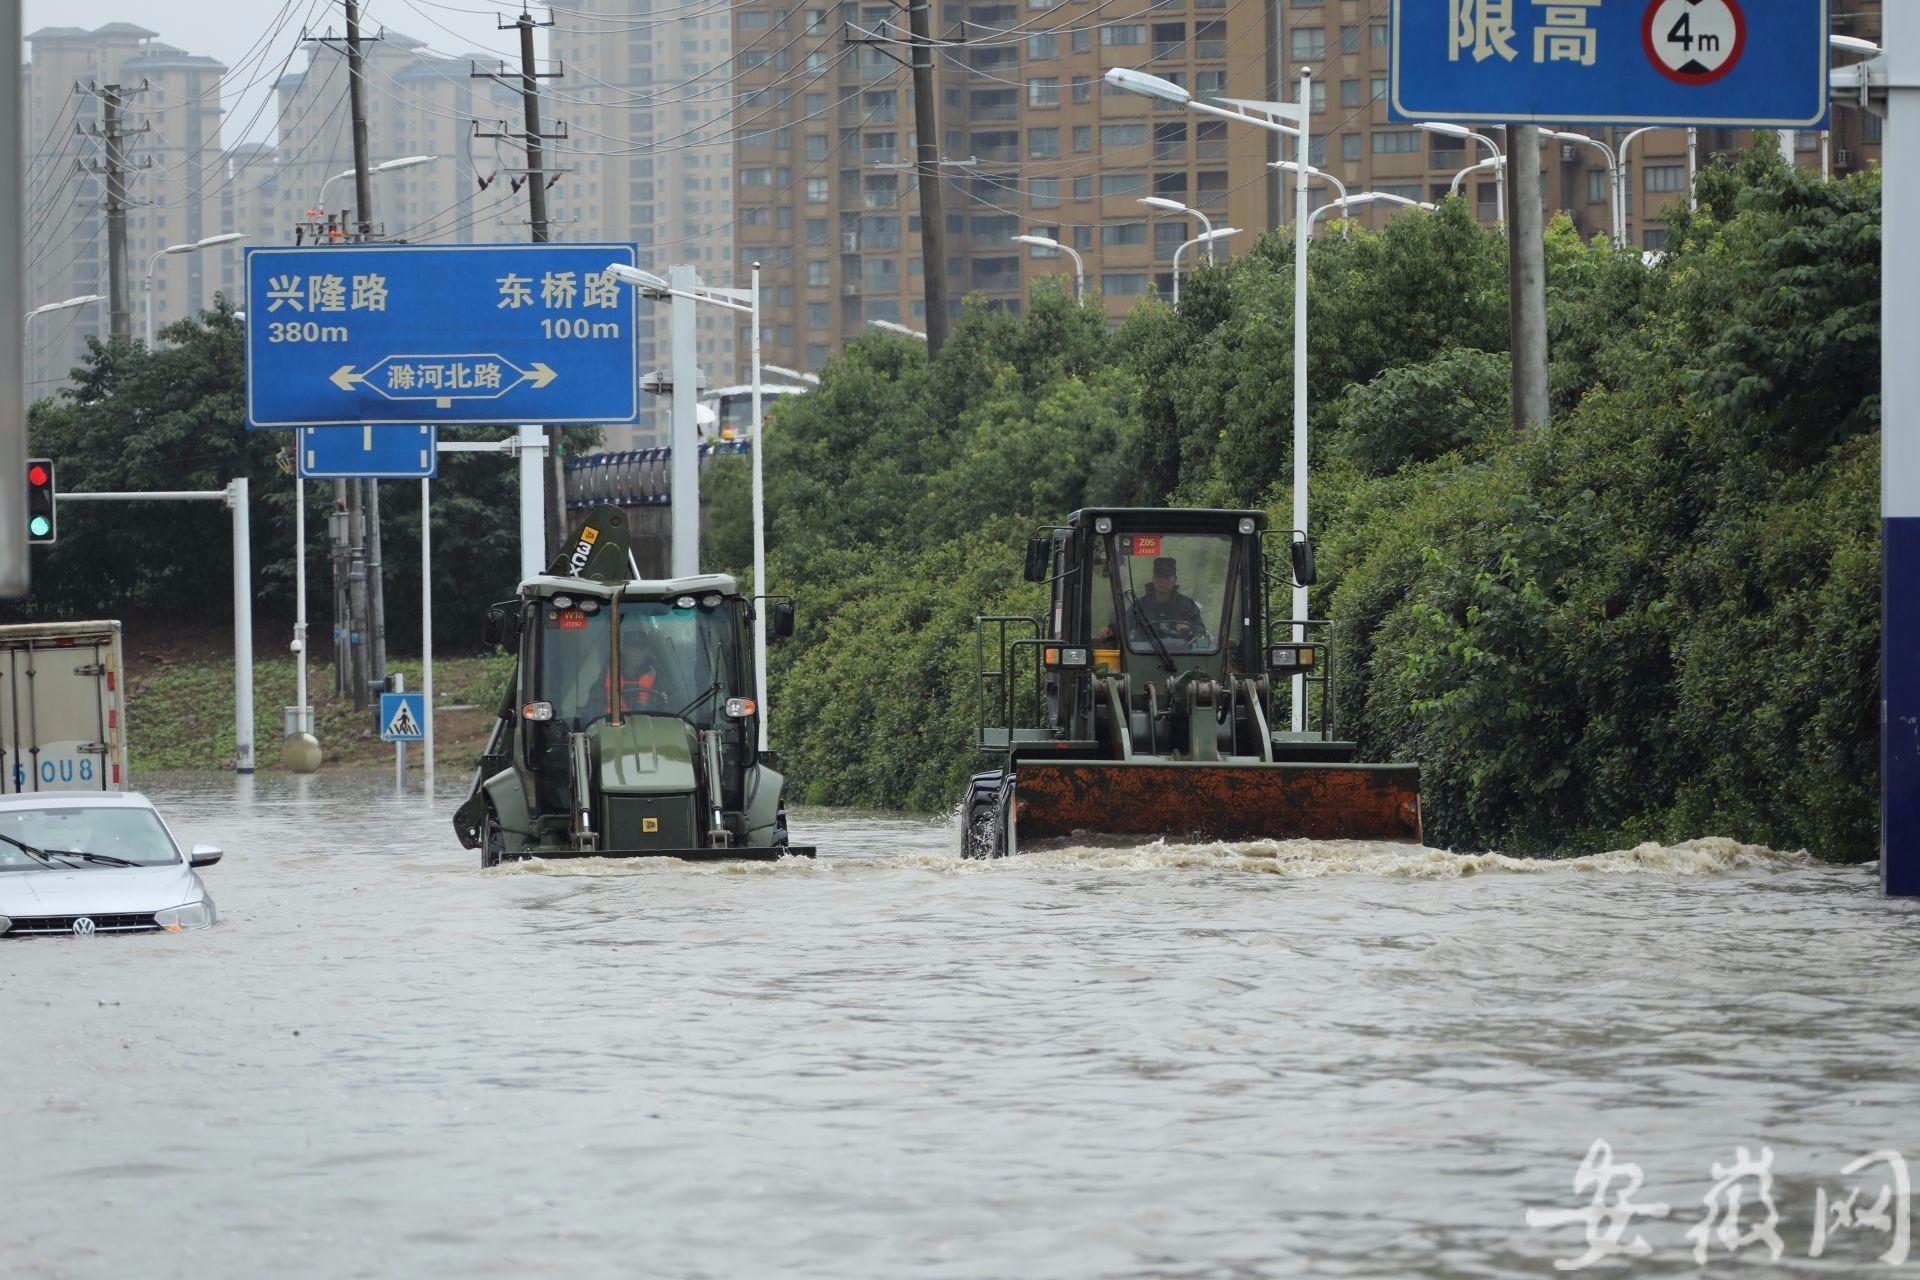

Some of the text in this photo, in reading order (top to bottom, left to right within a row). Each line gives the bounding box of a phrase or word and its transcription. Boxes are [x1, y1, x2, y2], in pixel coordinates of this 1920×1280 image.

[1448, 0, 1598, 66] 限高
[1666, 12, 1720, 52] 4m
[266, 273, 389, 313] 兴隆路
[496, 271, 621, 309] 东桥路
[268, 321, 348, 343] 380m
[540, 318, 620, 339] 100m
[387, 363, 502, 390] 滁河北路
